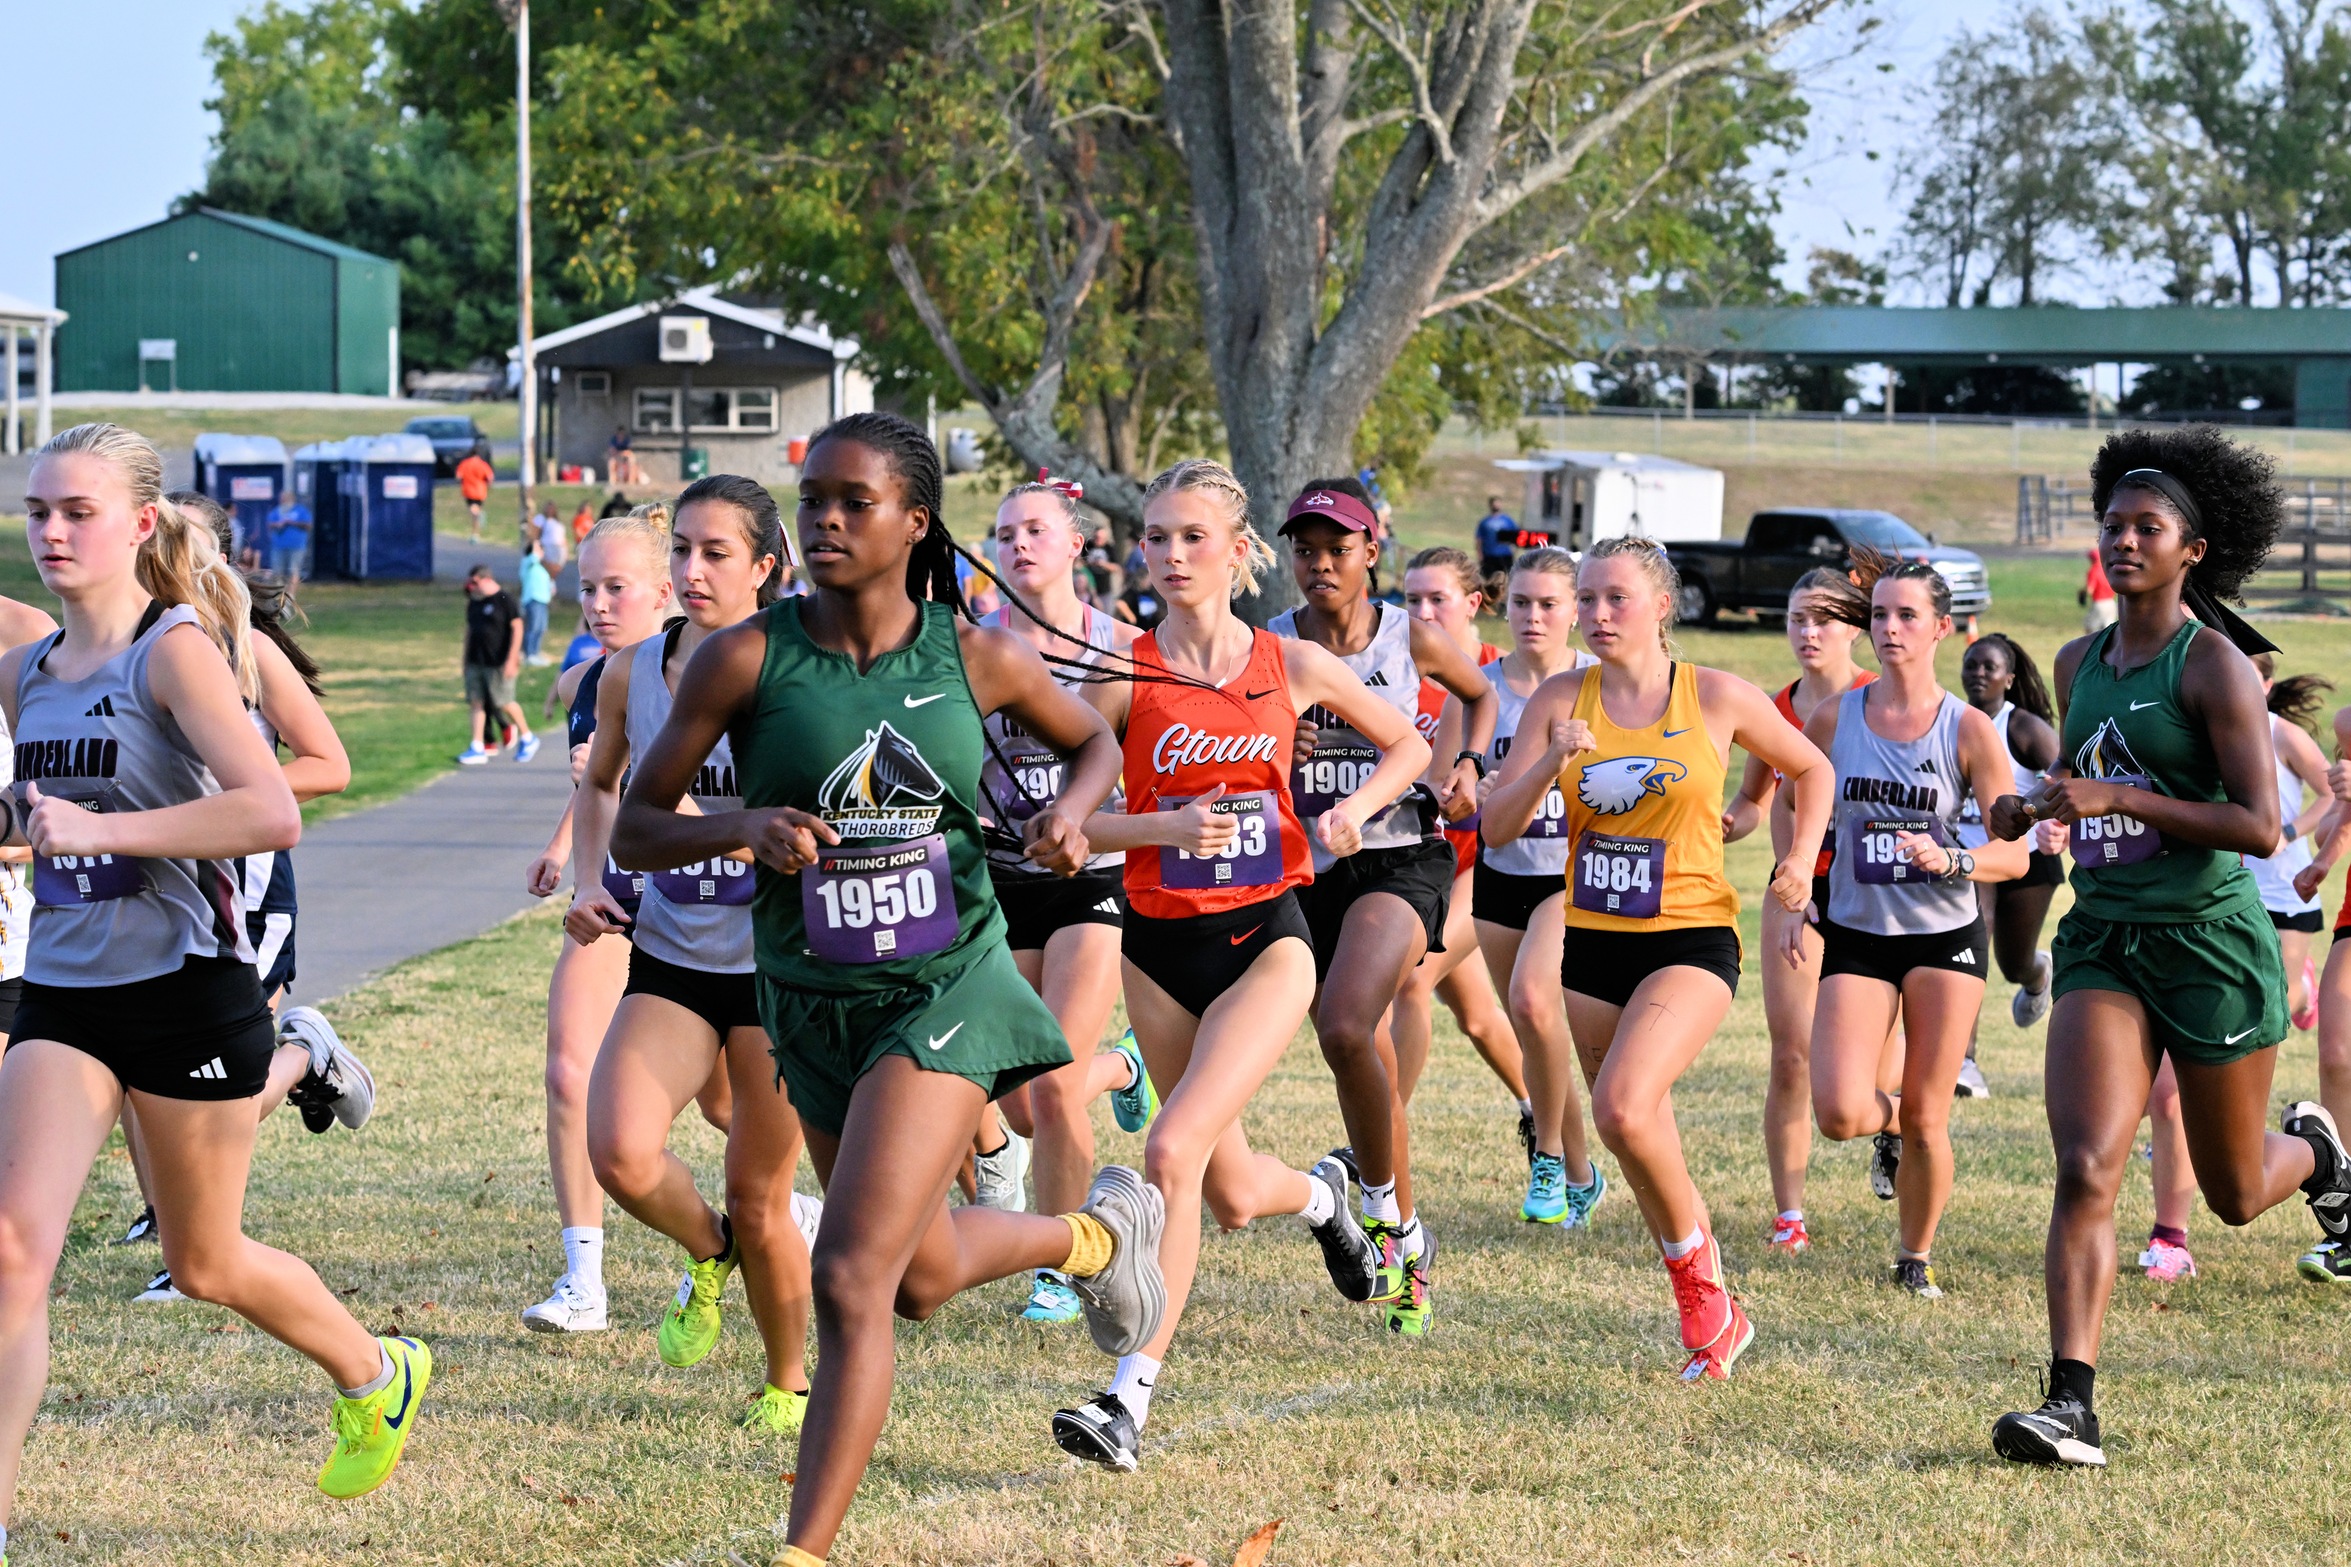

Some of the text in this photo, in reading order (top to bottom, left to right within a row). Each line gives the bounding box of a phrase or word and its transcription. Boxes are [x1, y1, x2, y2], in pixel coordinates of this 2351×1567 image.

[1152, 722, 1277, 776] Gtown
[1350, 748, 1374, 758] KING
[1843, 776, 1938, 812] CUMBERLAND
[1232, 799, 1260, 811] KING
[822, 808, 939, 821] KENTUCKY STATE
[840, 821, 933, 836] THOROBREDS
[1906, 821, 1929, 830] KING
[1623, 843, 1649, 853] KING
[889, 848, 925, 867] KING
[1582, 851, 1652, 893] 1984
[816, 868, 937, 928] 1950
